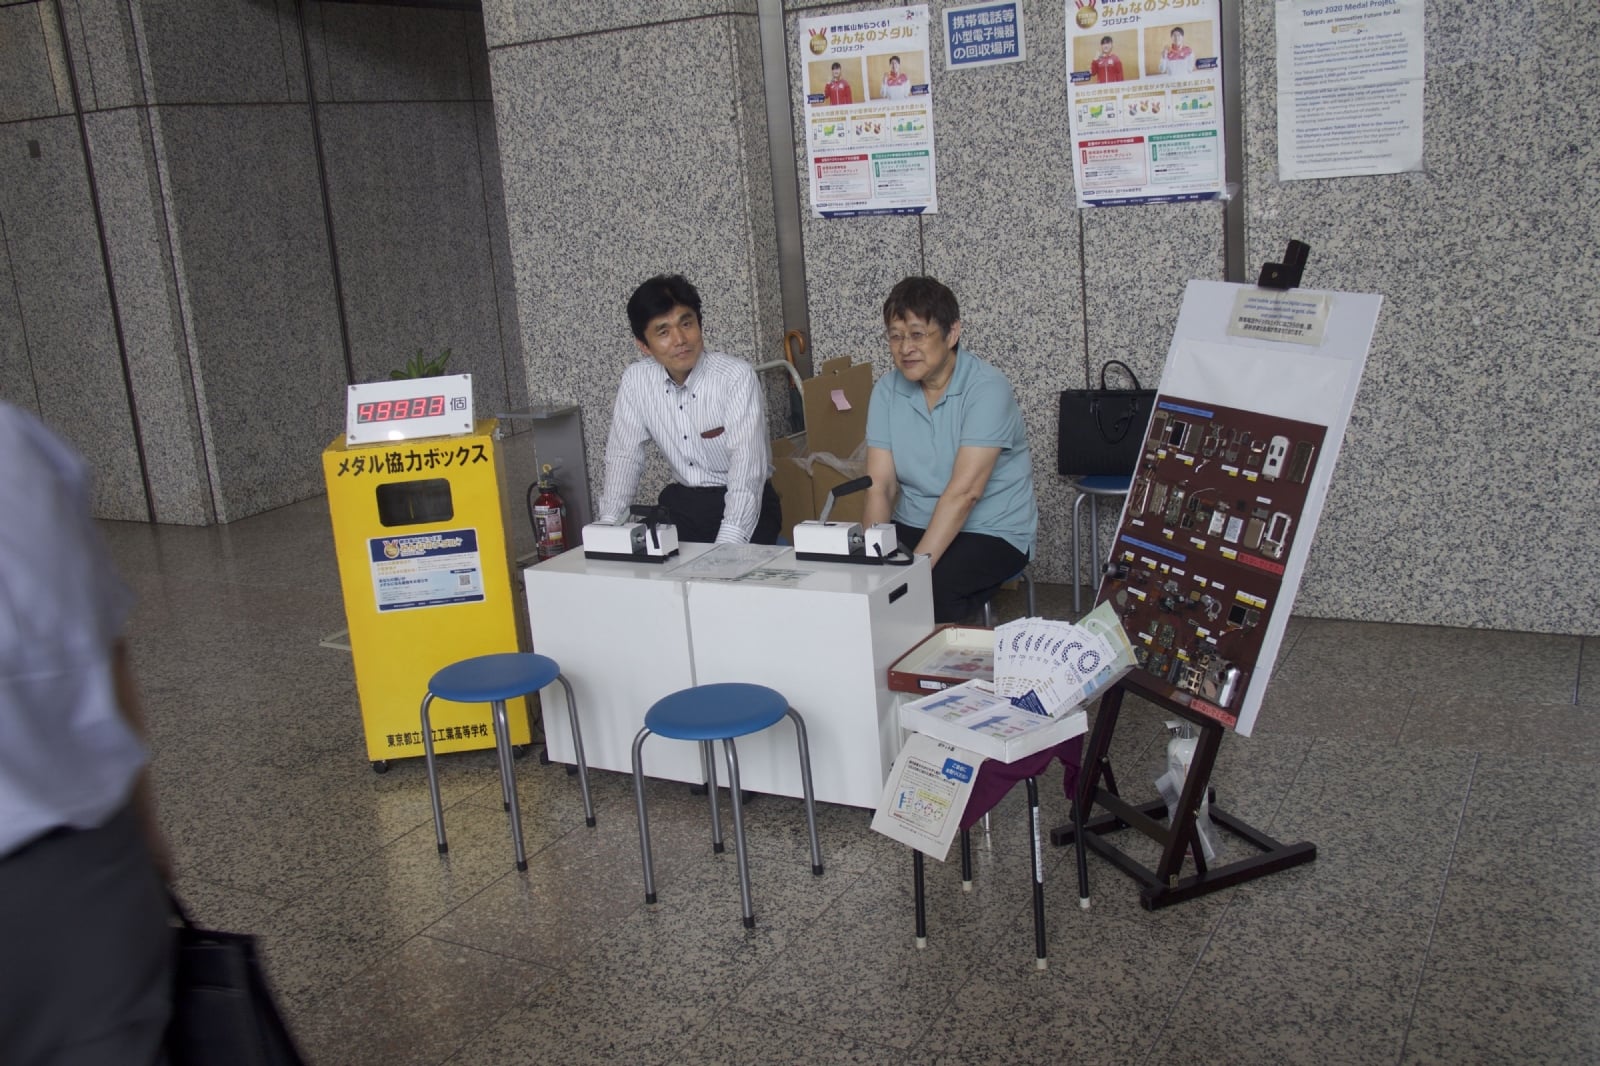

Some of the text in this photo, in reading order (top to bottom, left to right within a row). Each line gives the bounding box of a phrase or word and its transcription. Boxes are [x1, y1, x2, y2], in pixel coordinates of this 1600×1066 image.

[952, 8, 1015, 30] 携帯電話等
[1302, 8, 1323, 17] Tokyo
[1325, 6, 1343, 15] 2020
[1344, 2, 1368, 11] Medal
[1101, 15, 1141, 27] プロジェクト
[1303, 19, 1326, 27] Towards
[831, 25, 913, 46] みんなのメダル
[951, 24, 1015, 45] 小型電子機器
[830, 44, 865, 54] プロジェクト
[953, 40, 1016, 60] の回収場所
[359, 396, 467, 422] 49933 個
[337, 443, 489, 477] メダル協力ボックス
[386, 722, 489, 748] 東京都立立工業高等学校
